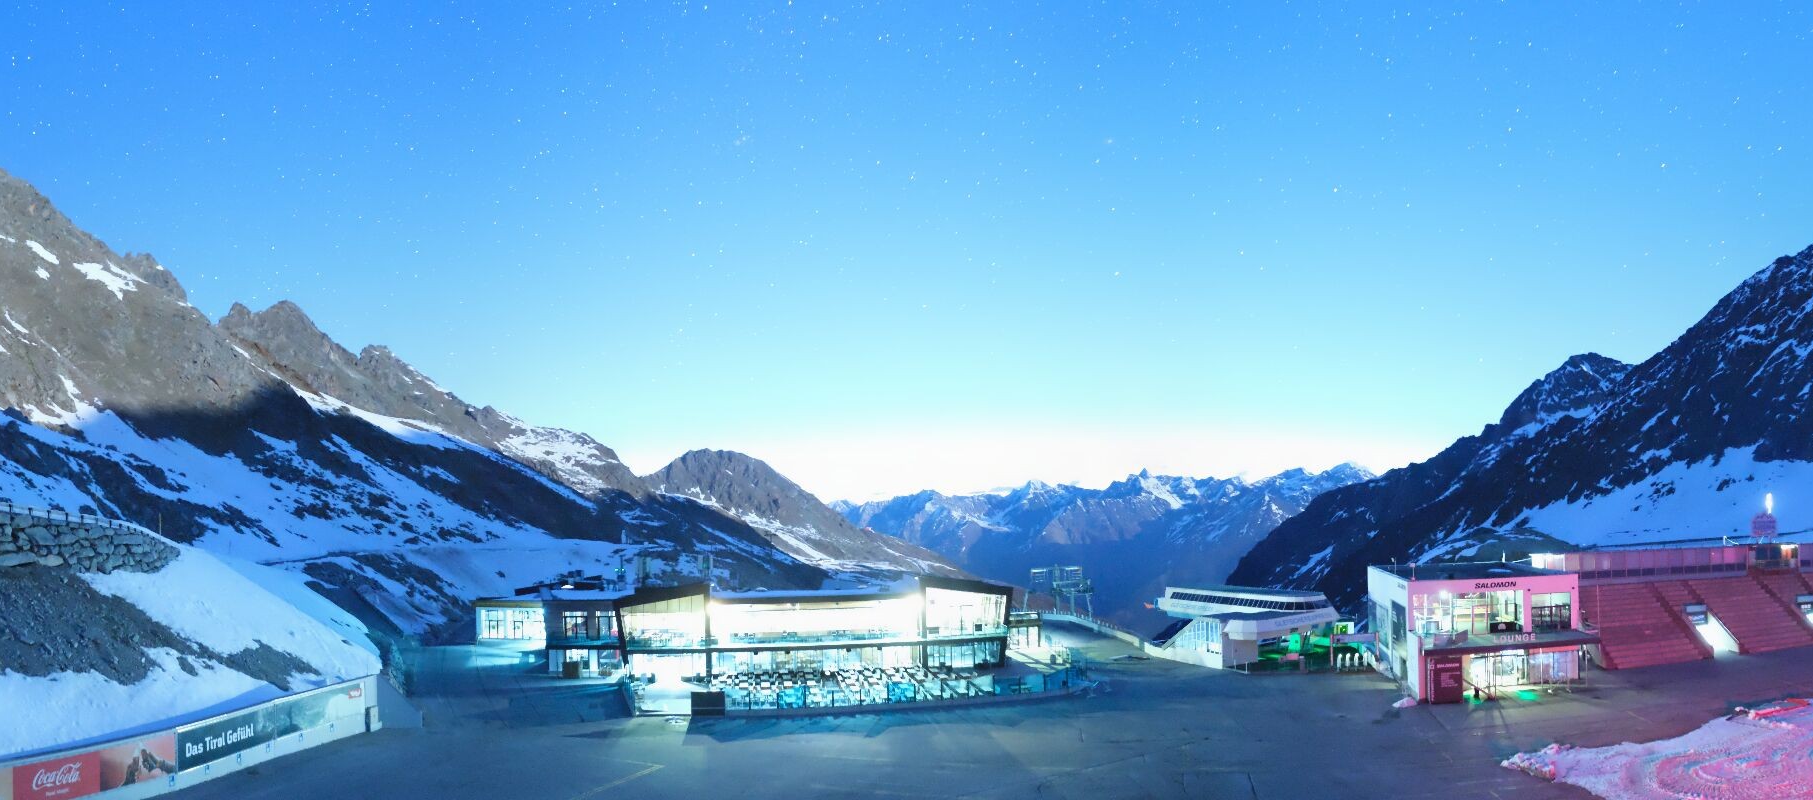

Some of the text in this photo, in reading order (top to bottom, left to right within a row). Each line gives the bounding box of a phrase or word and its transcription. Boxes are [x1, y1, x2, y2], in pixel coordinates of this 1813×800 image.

[1474, 581, 1517, 589] SALOMON
[1493, 633, 1536, 643] LOUNGE
[185, 723, 254, 758] Das Tirol Gefühl
[32, 761, 82, 790] Coca-Cola
